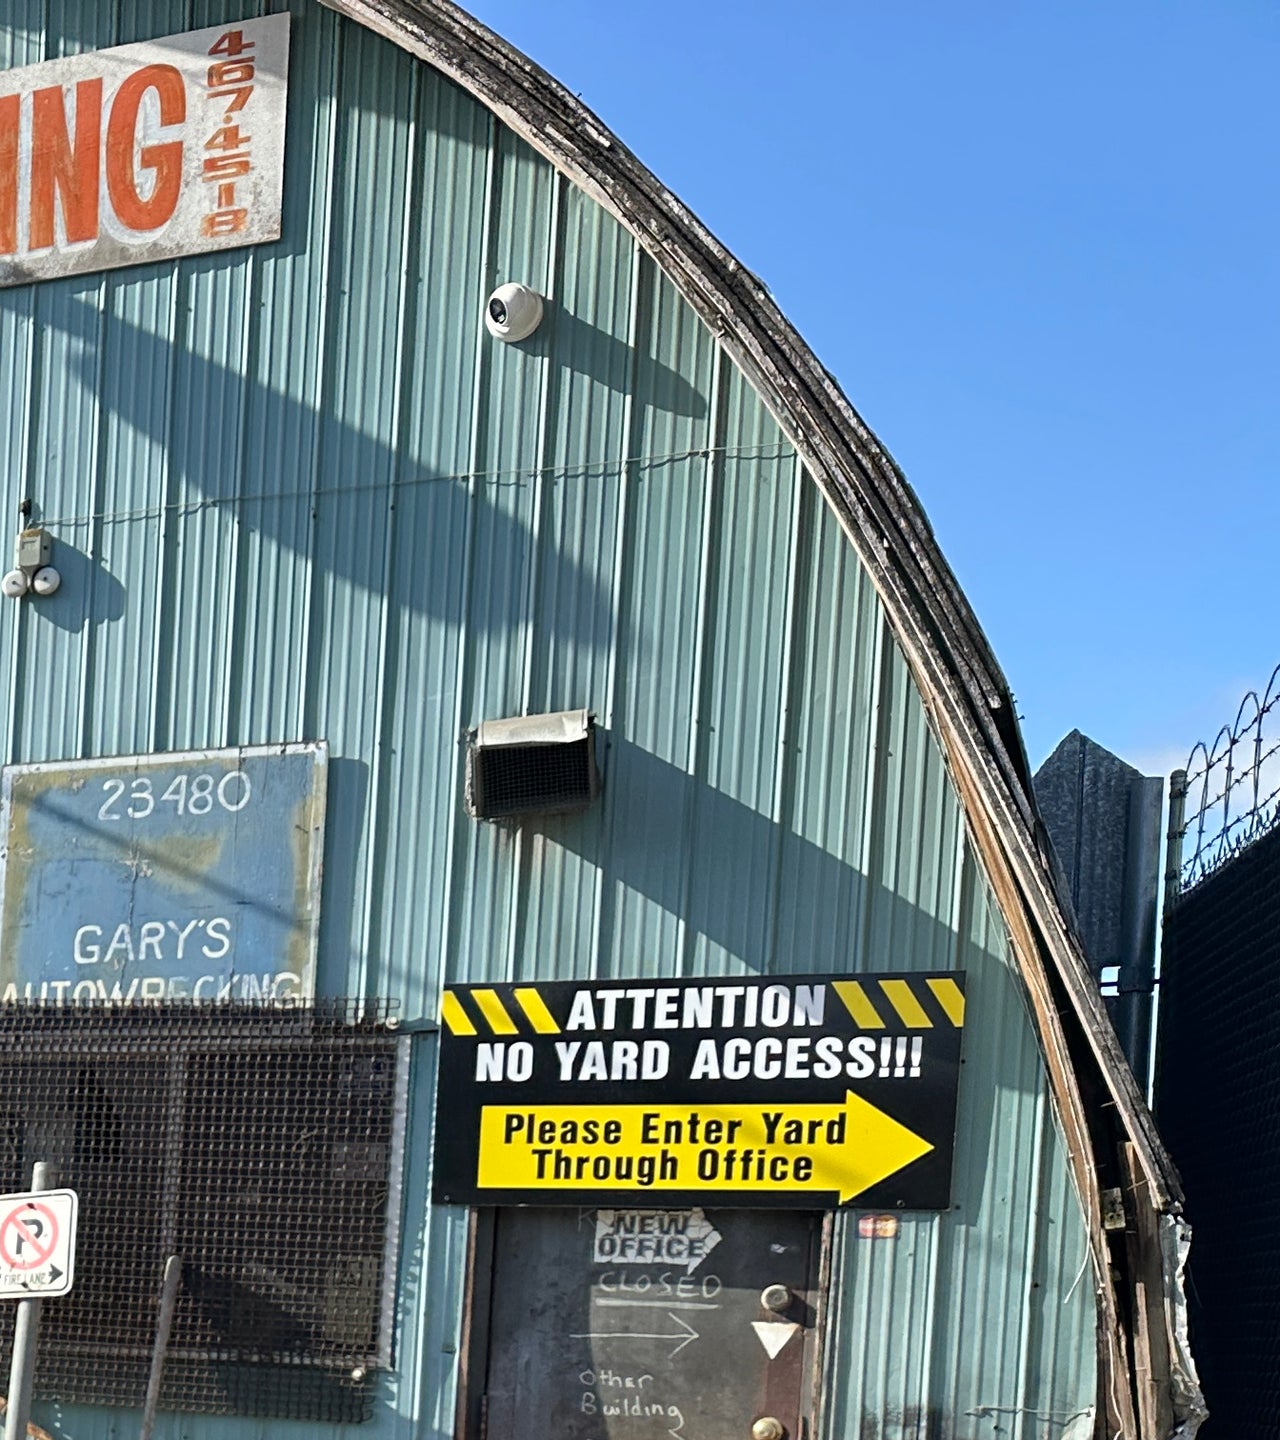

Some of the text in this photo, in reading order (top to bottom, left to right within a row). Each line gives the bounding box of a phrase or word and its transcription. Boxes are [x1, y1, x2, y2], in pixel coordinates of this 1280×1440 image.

[98, 771, 251, 821] 23480
[73, 917, 231, 965] GARY'S
[566, 985, 826, 1031] ATTENTION
[475, 1036, 923, 1082] NO YARD ACCESS!!!
[505, 1112, 848, 1145] Please Enter Yard
[532, 1148, 813, 1186] Through Office
[614, 1214, 690, 1235] NEW
[598, 1236, 706, 1259] OFFICE
[4, 1274, 21, 1286] FIRE
[598, 1271, 722, 1298] CLOSED
[580, 1392, 685, 1431] Building
